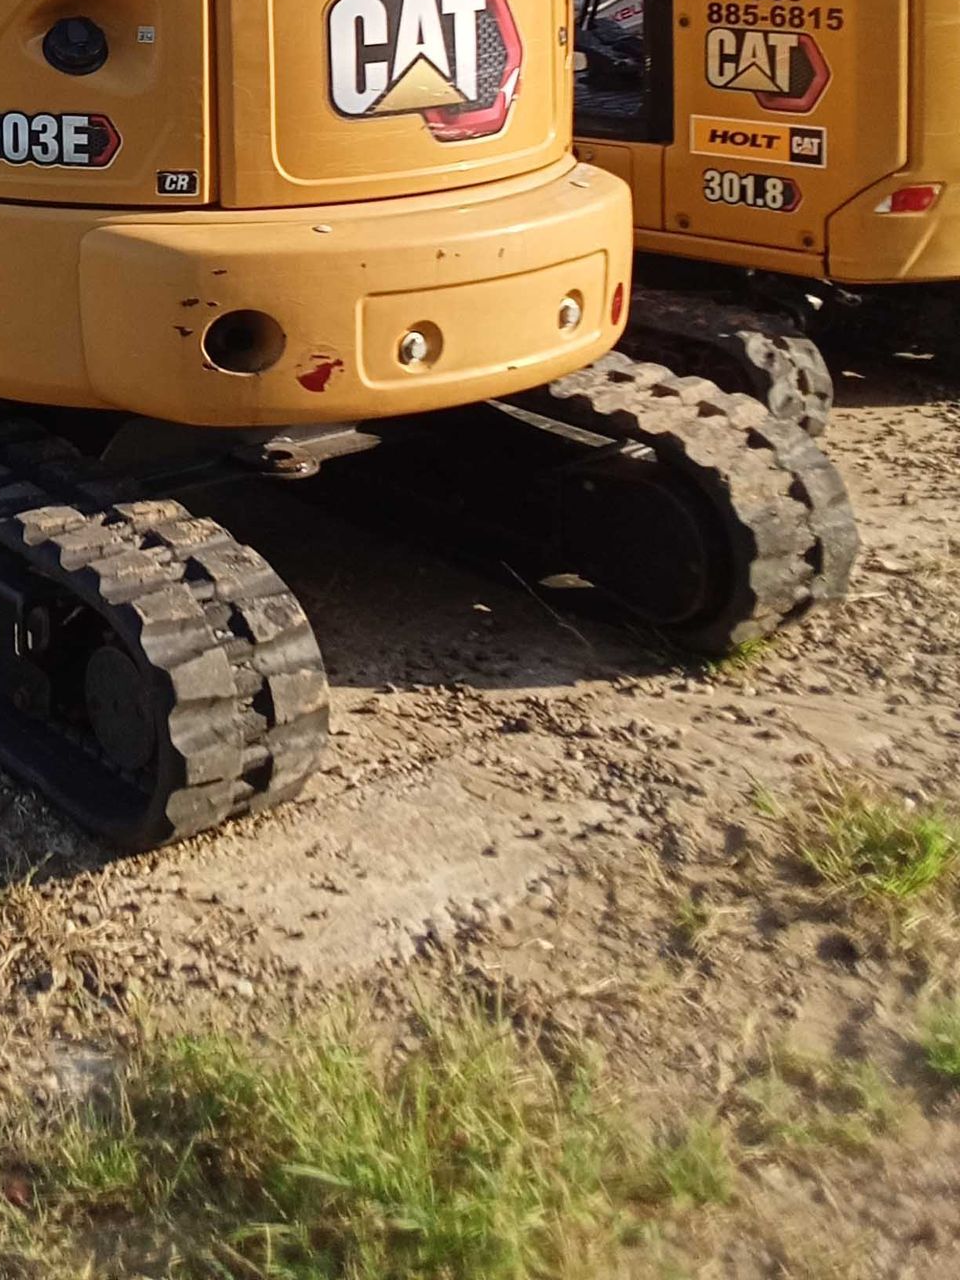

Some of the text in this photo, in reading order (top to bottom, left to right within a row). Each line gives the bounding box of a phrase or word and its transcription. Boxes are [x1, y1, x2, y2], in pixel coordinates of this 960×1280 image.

[707, 2, 844, 30] 885-6815
[707, 28, 798, 93] CAT
[708, 129, 821, 156] HOLT CAT
[164, 174, 189, 191] CR
[704, 170, 783, 209] 301.8
